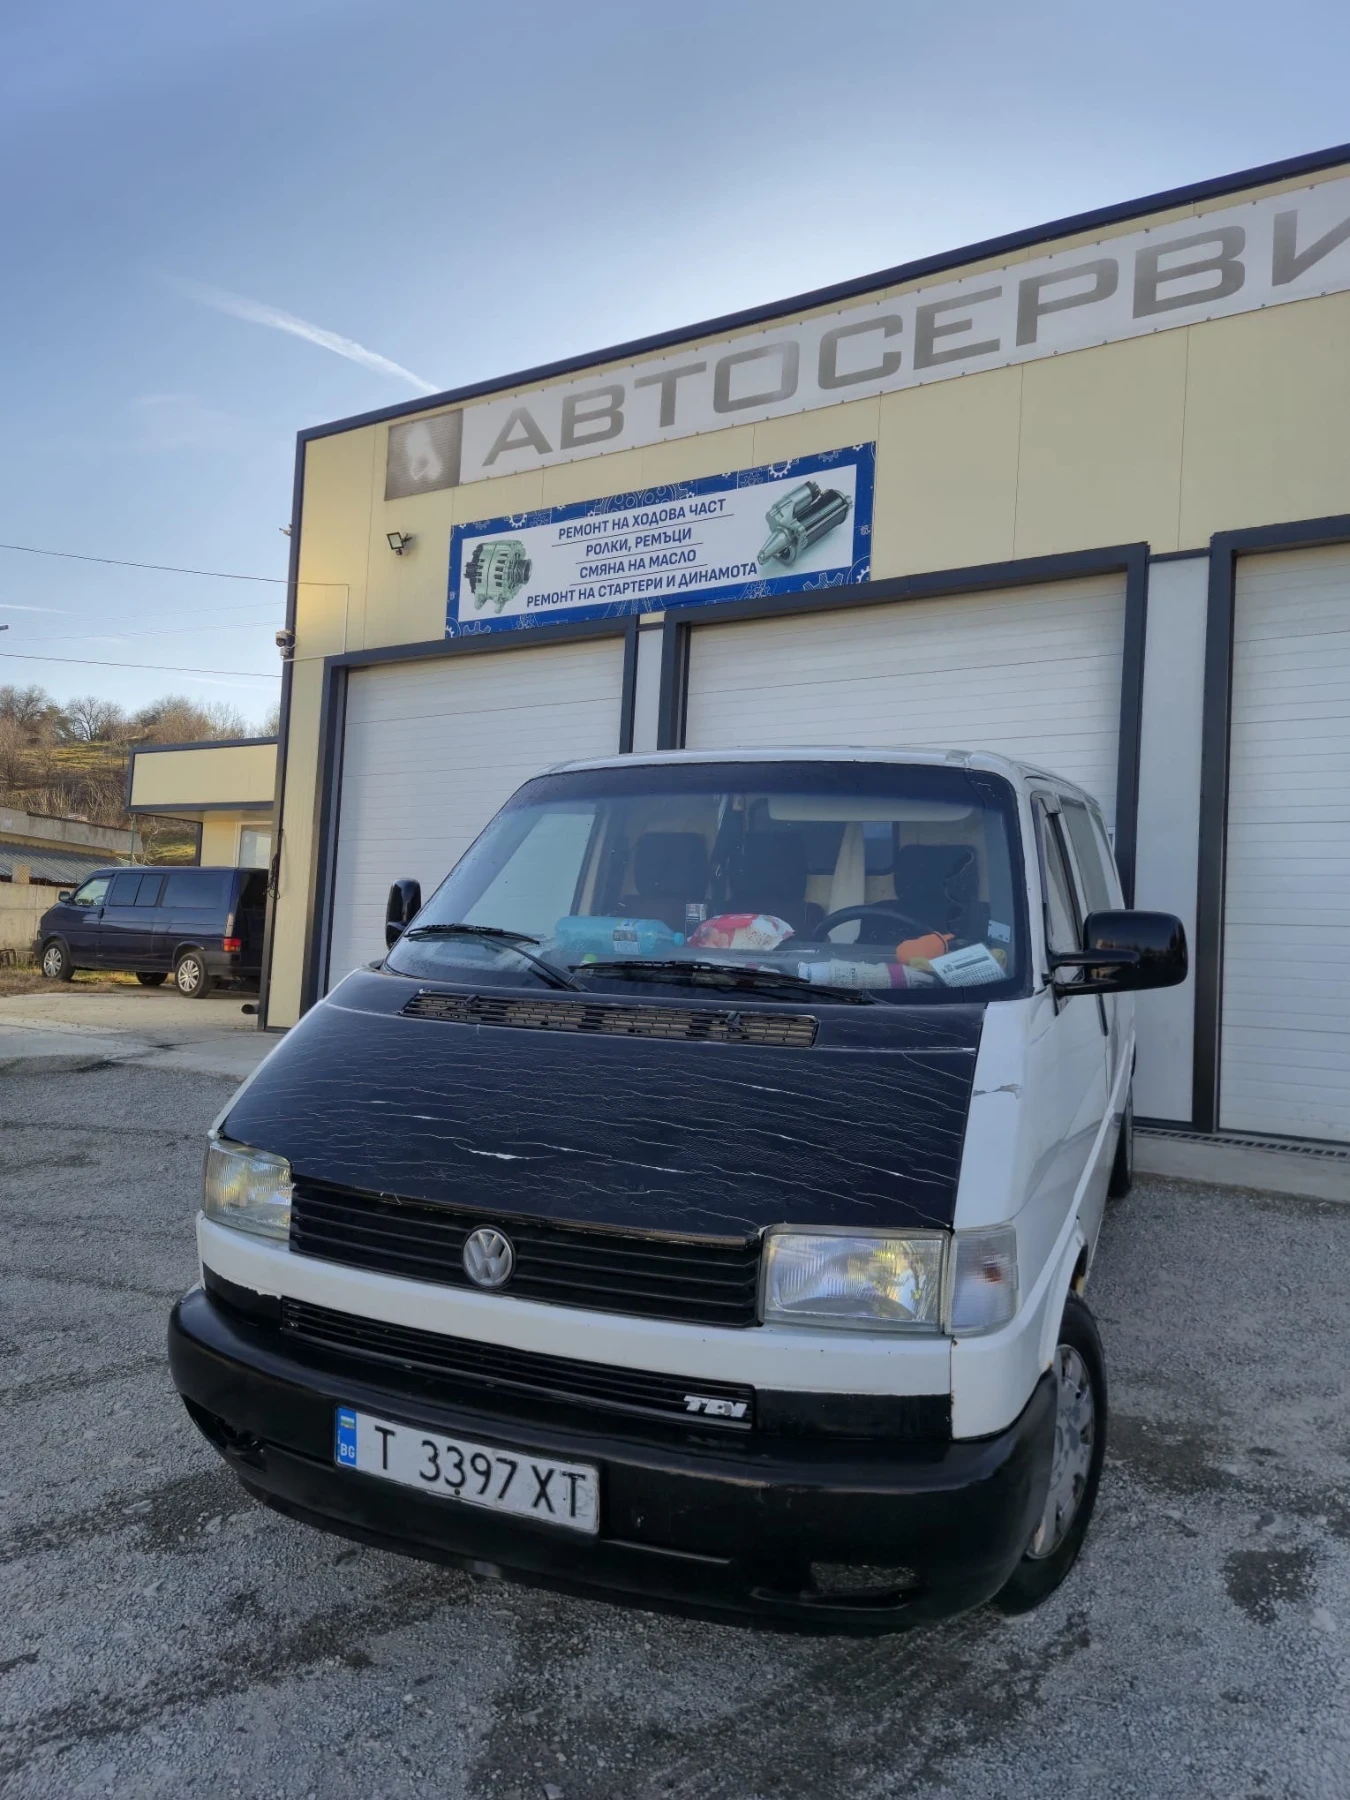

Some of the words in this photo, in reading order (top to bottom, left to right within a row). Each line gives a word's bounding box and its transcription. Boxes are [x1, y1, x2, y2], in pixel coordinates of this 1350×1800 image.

[558, 521, 608, 540] РЕМОНТ
[612, 518, 630, 531] НА
[632, 506, 686, 528] ХОДОВА
[689, 498, 727, 516] ЧАСТ
[585, 538, 632, 557] РОЛКИ,
[635, 527, 692, 549] РЕМЪЦИ
[579, 562, 625, 579] СМЯНА
[628, 558, 646, 571] НА
[649, 549, 697, 569] МАСЛО
[526, 589, 576, 608] РЕМОНТ
[578, 586, 596, 600] НА
[598, 575, 664, 598] СТАРТЕРИ
[666, 574, 676, 588] И
[678, 562, 758, 589] ДИНАМОТА
[339, 1442, 356, 1459] BG
[419, 1439, 518, 1501] 3397
